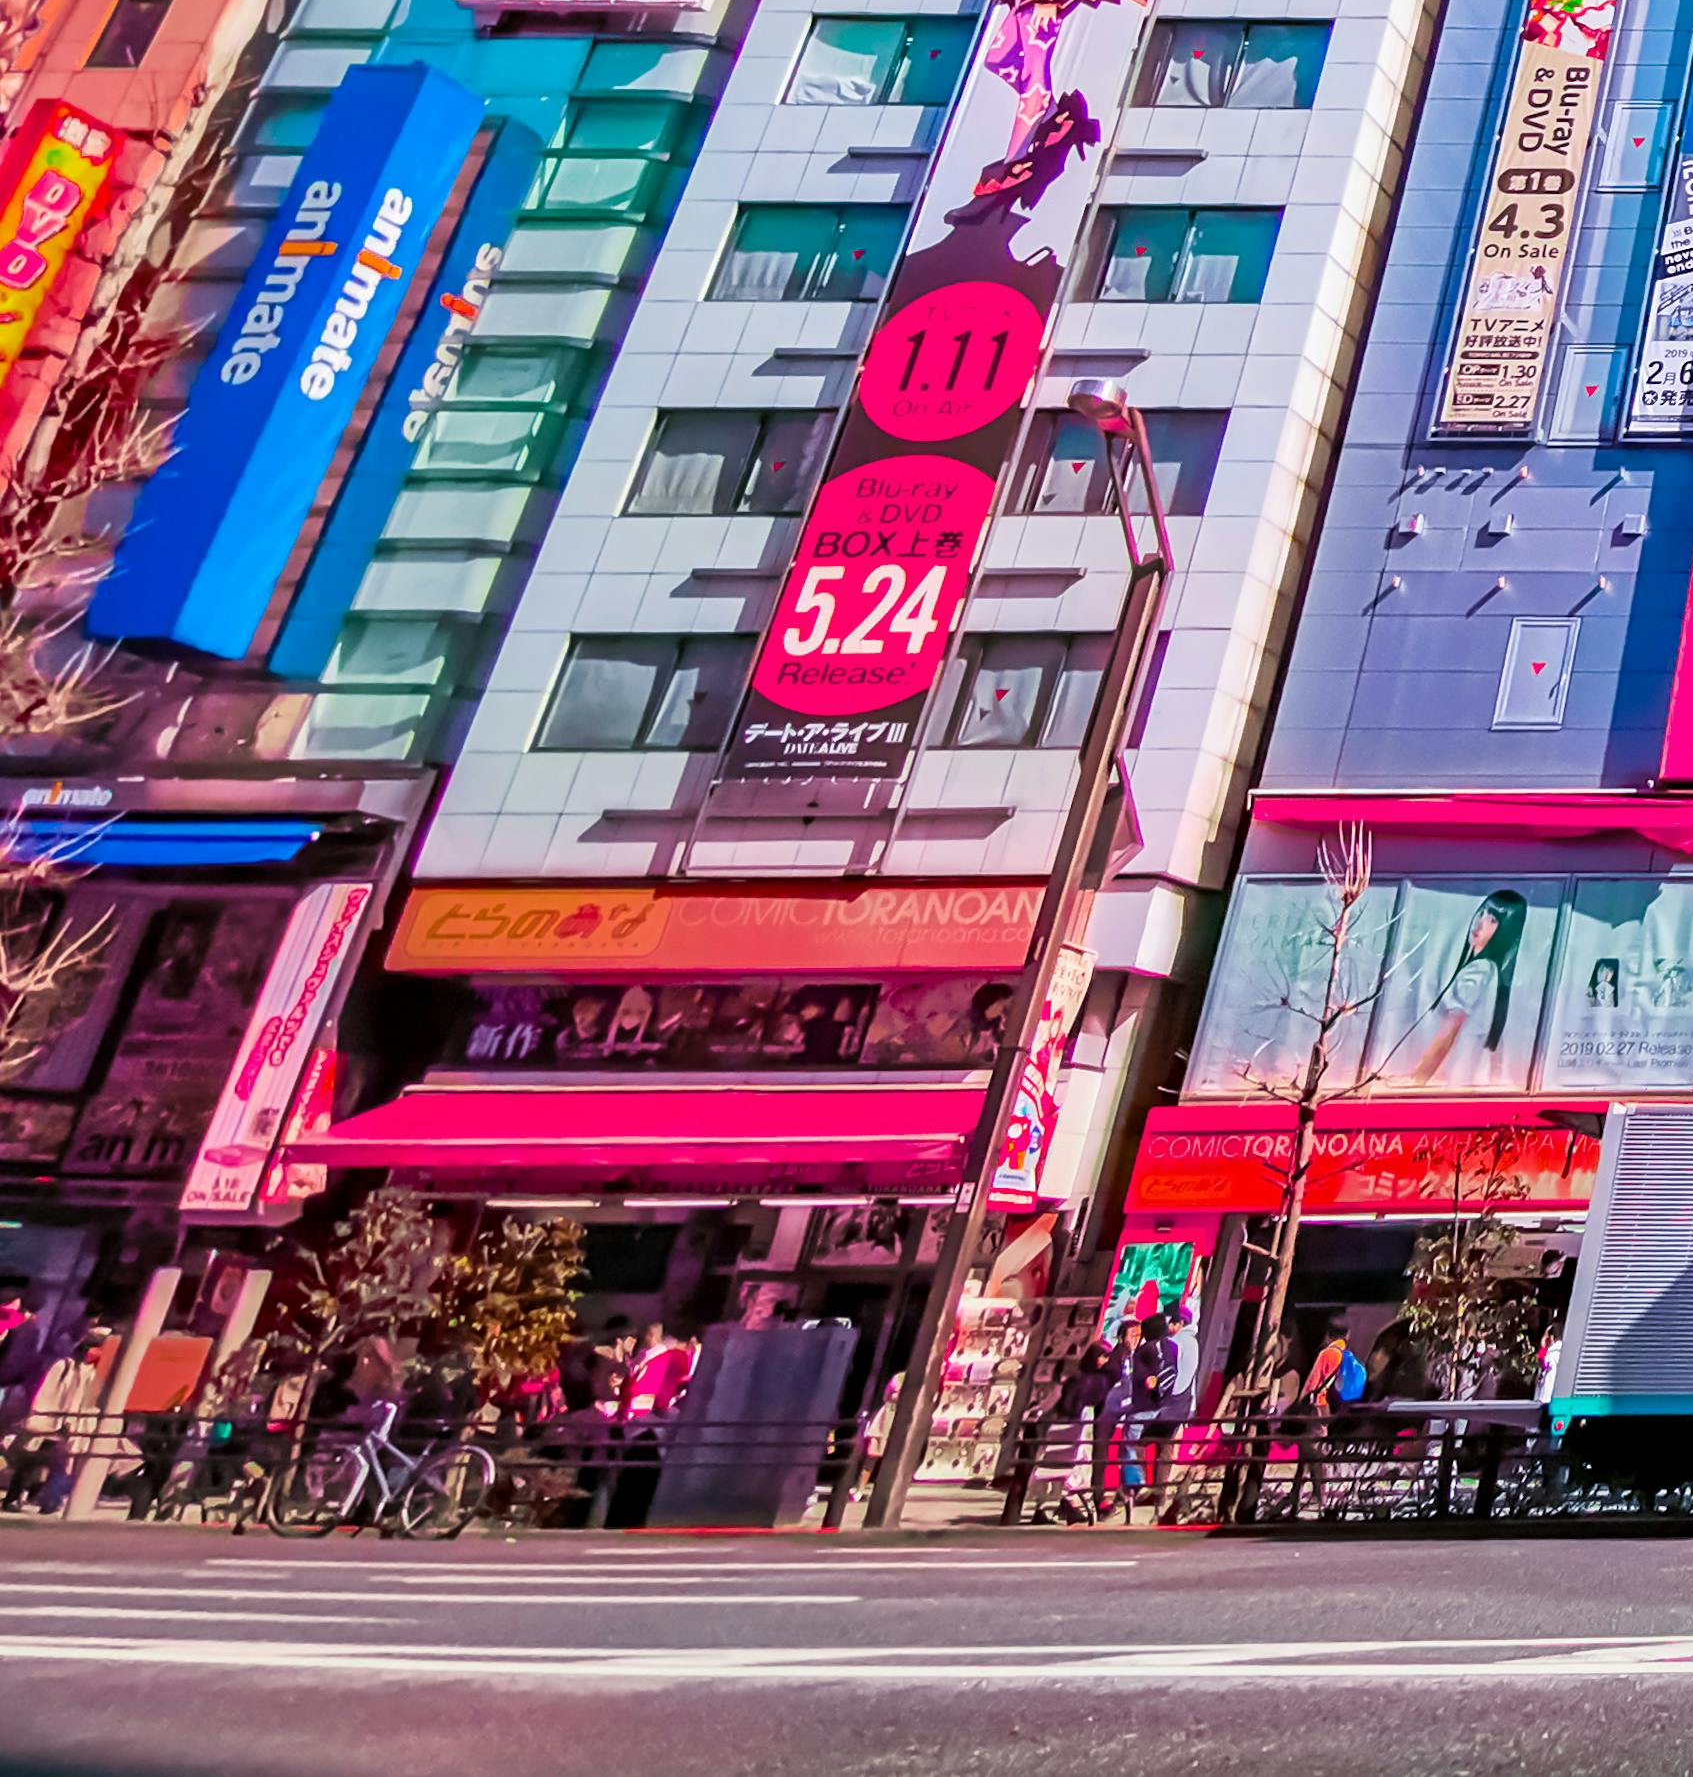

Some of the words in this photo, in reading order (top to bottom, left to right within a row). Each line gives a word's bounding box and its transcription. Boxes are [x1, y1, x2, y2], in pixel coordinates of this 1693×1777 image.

[1517, 88, 1553, 153] DVD
[1543, 66, 1591, 156] Blu-ray
[1488, 202, 1565, 239] 4.3
[1483, 243, 1511, 258] On
[1518, 243, 1560, 259] Sale
[220, 179, 342, 387] animate
[300, 187, 414, 401] animate
[1470, 318, 1545, 333] TVアニメ
[899, 328, 1011, 393] 1.11
[856, 477, 958, 500] Blu-ray
[878, 504, 943, 524] DVD
[812, 531, 965, 559] BOX上巻
[782, 564, 949, 658] 5.24
